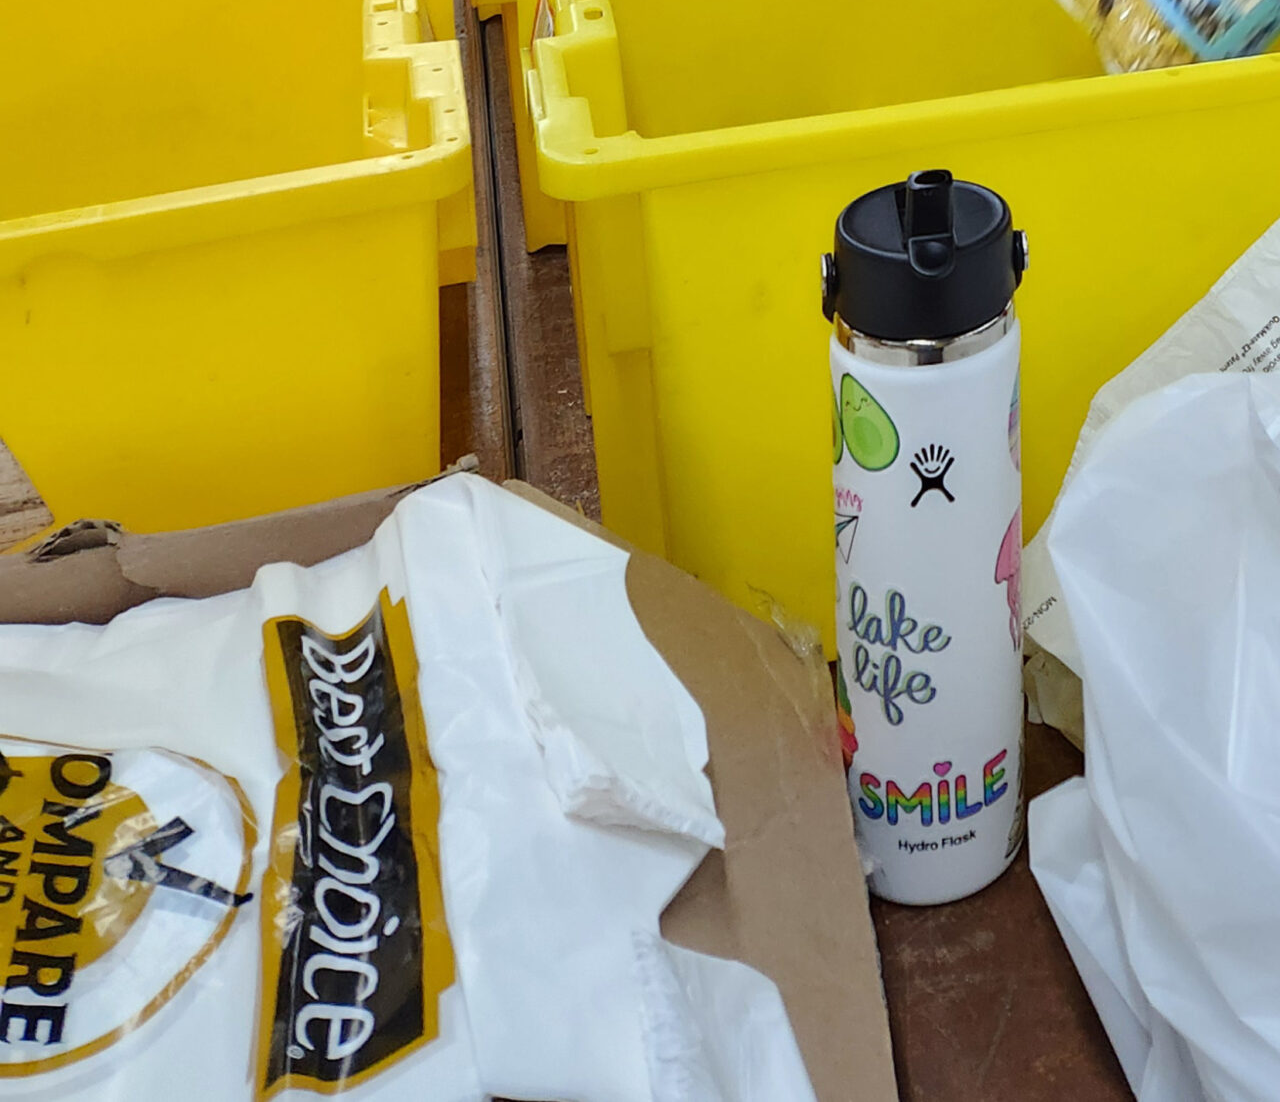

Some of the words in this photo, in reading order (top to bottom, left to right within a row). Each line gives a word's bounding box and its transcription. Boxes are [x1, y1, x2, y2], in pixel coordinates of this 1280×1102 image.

[1252, 347, 1272, 366] away
[848, 581, 952, 654] lake
[300, 633, 386, 776] Best
[853, 642, 936, 726] life
[898, 839, 938, 855] Hydro
[942, 829, 977, 849] Flask
[0, 753, 113, 1046] OMPARE
[295, 782, 400, 1061] Choice
